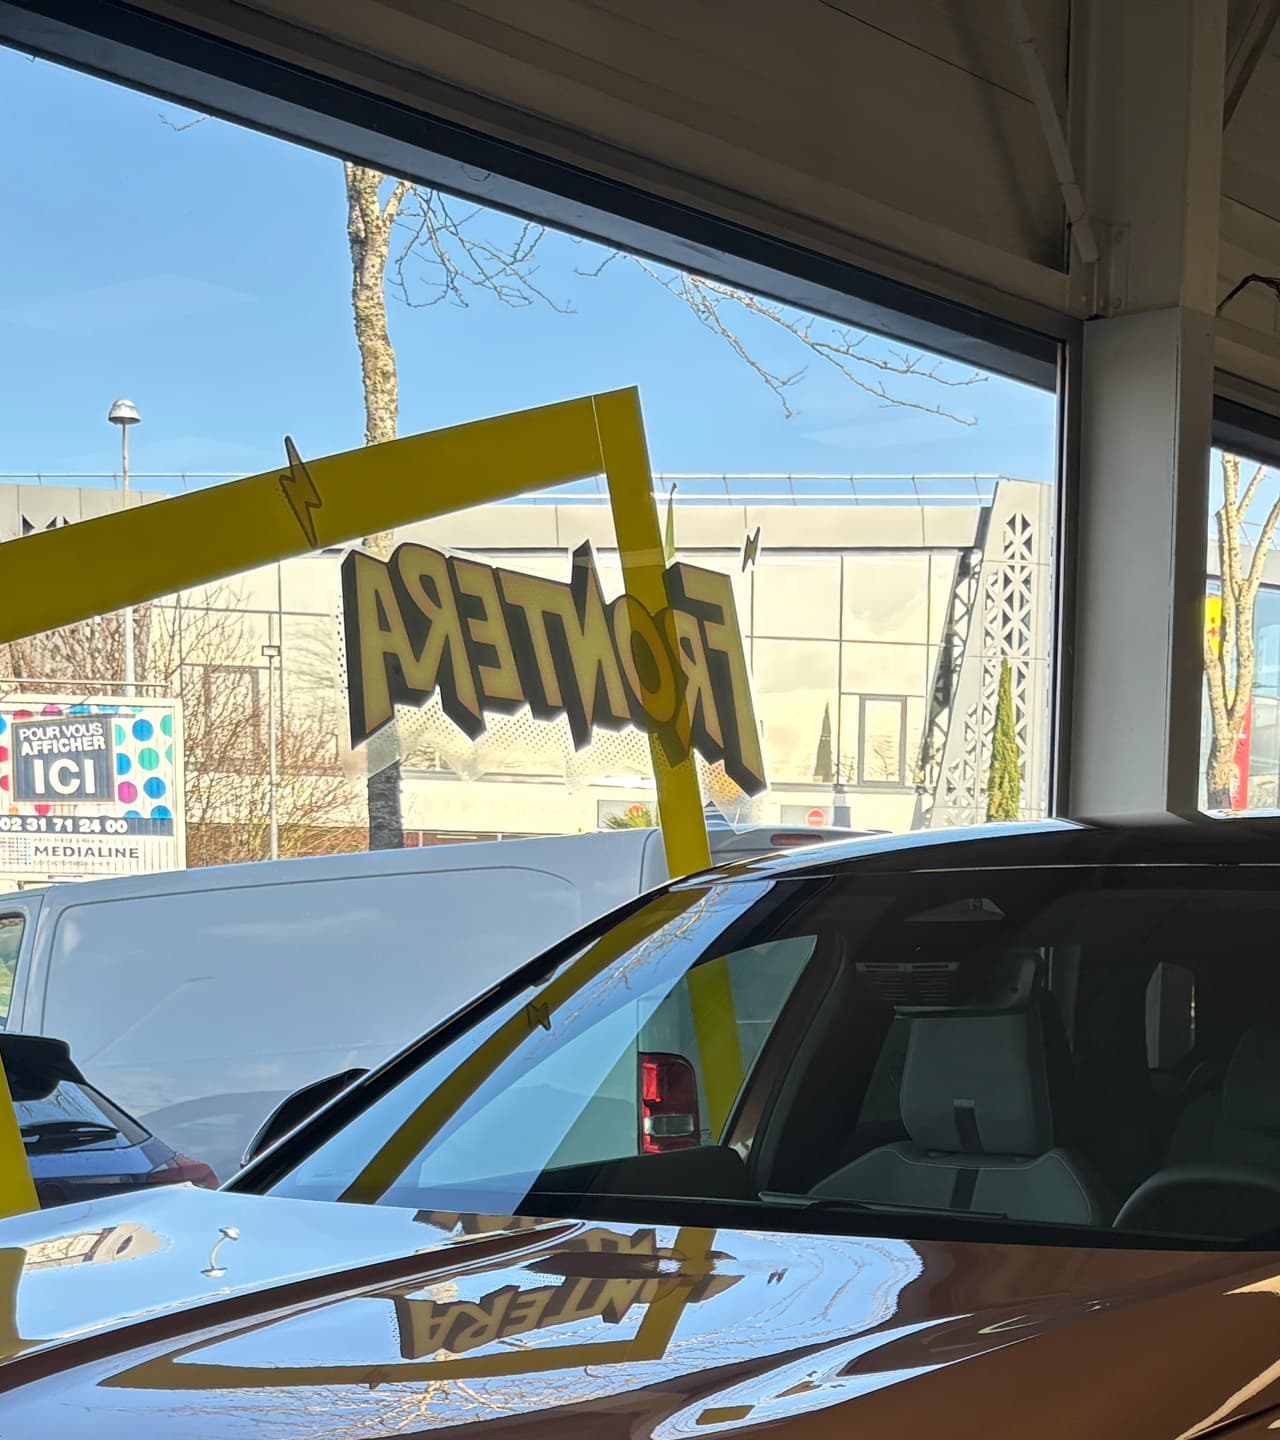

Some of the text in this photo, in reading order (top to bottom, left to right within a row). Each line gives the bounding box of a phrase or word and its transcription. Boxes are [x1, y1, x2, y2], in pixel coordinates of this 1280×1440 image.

[19, 722, 103, 741] POUR VOUS
[21, 735, 106, 757] AFFICHER
[33, 758, 96, 795] ICI
[0, 816, 128, 834] 02 31 71 24 00
[34, 845, 140, 859] MEDIALINE
